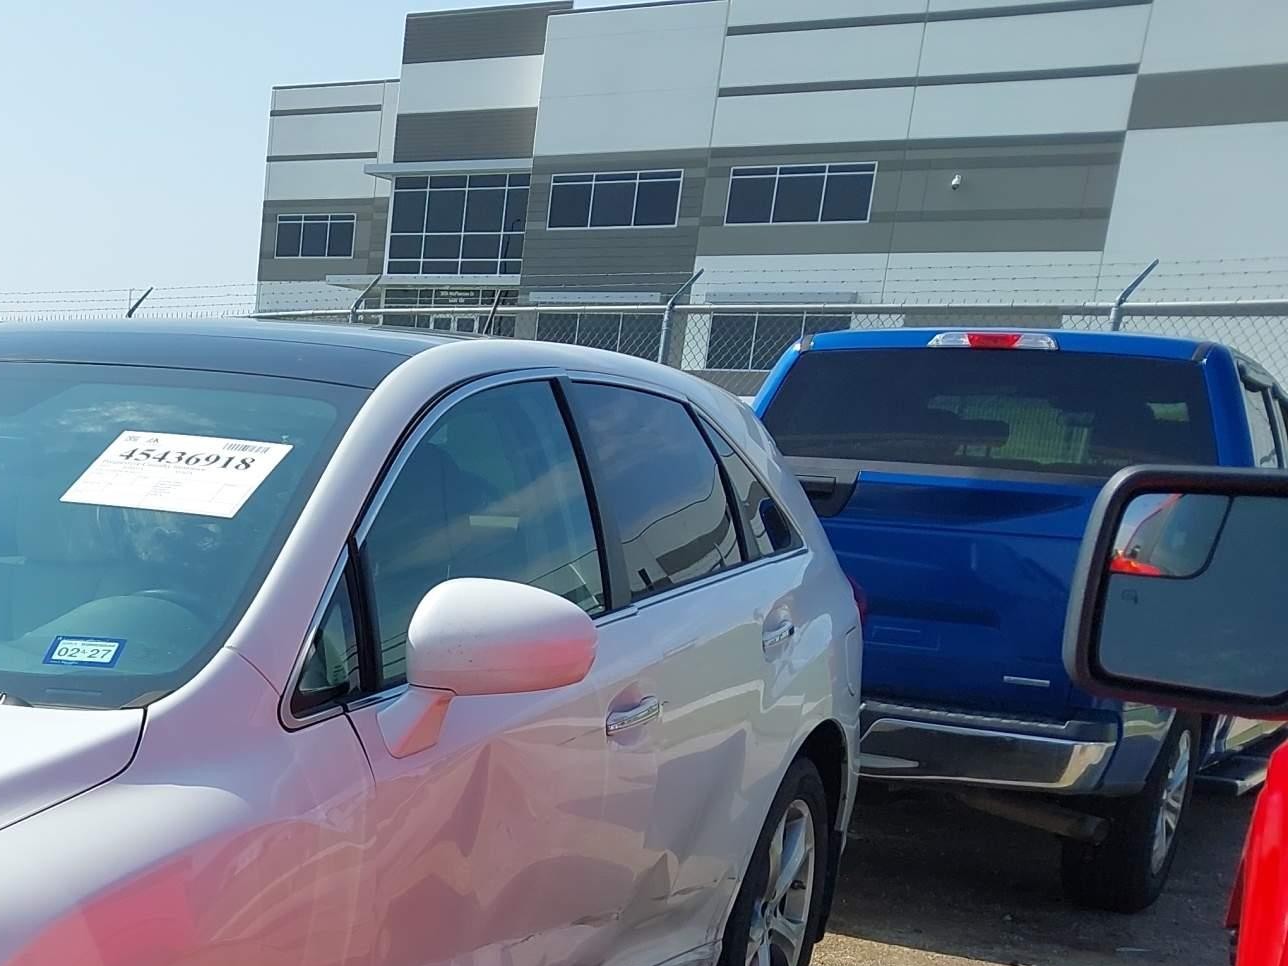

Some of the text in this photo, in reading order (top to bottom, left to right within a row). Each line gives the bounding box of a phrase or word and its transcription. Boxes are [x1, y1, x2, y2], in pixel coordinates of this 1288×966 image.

[119, 447, 256, 470] 45436918
[57, 647, 112, 659] 02 27
